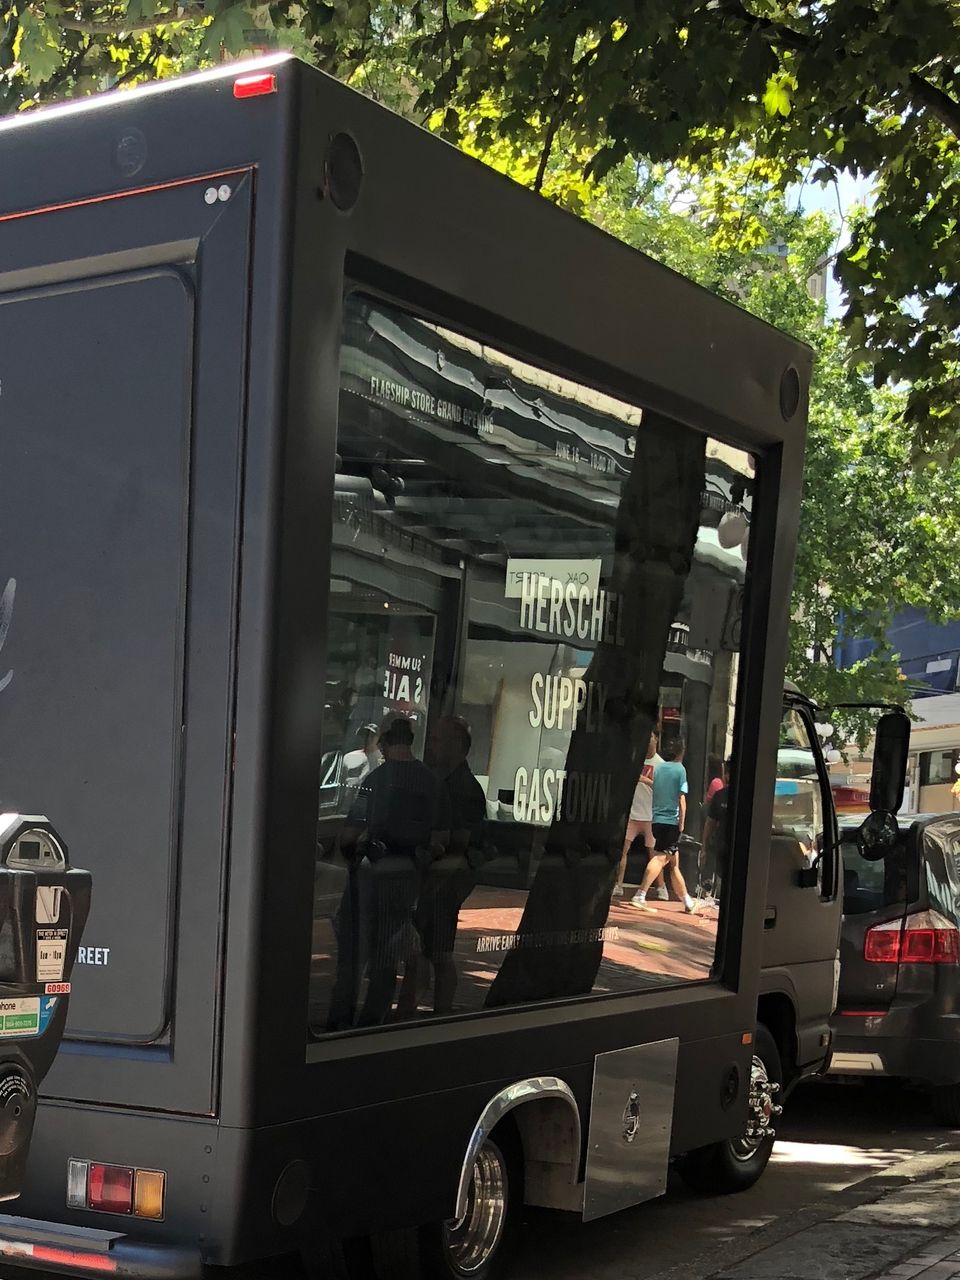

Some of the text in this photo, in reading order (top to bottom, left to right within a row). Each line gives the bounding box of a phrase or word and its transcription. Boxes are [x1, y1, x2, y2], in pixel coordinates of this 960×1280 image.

[370, 376, 410, 404] FLAGSHIP
[410, 390, 435, 414] STORE
[436, 399, 461, 424] GRAND
[519, 572, 625, 647] HERSCHEL
[513, 766, 611, 824] GASTOWN
